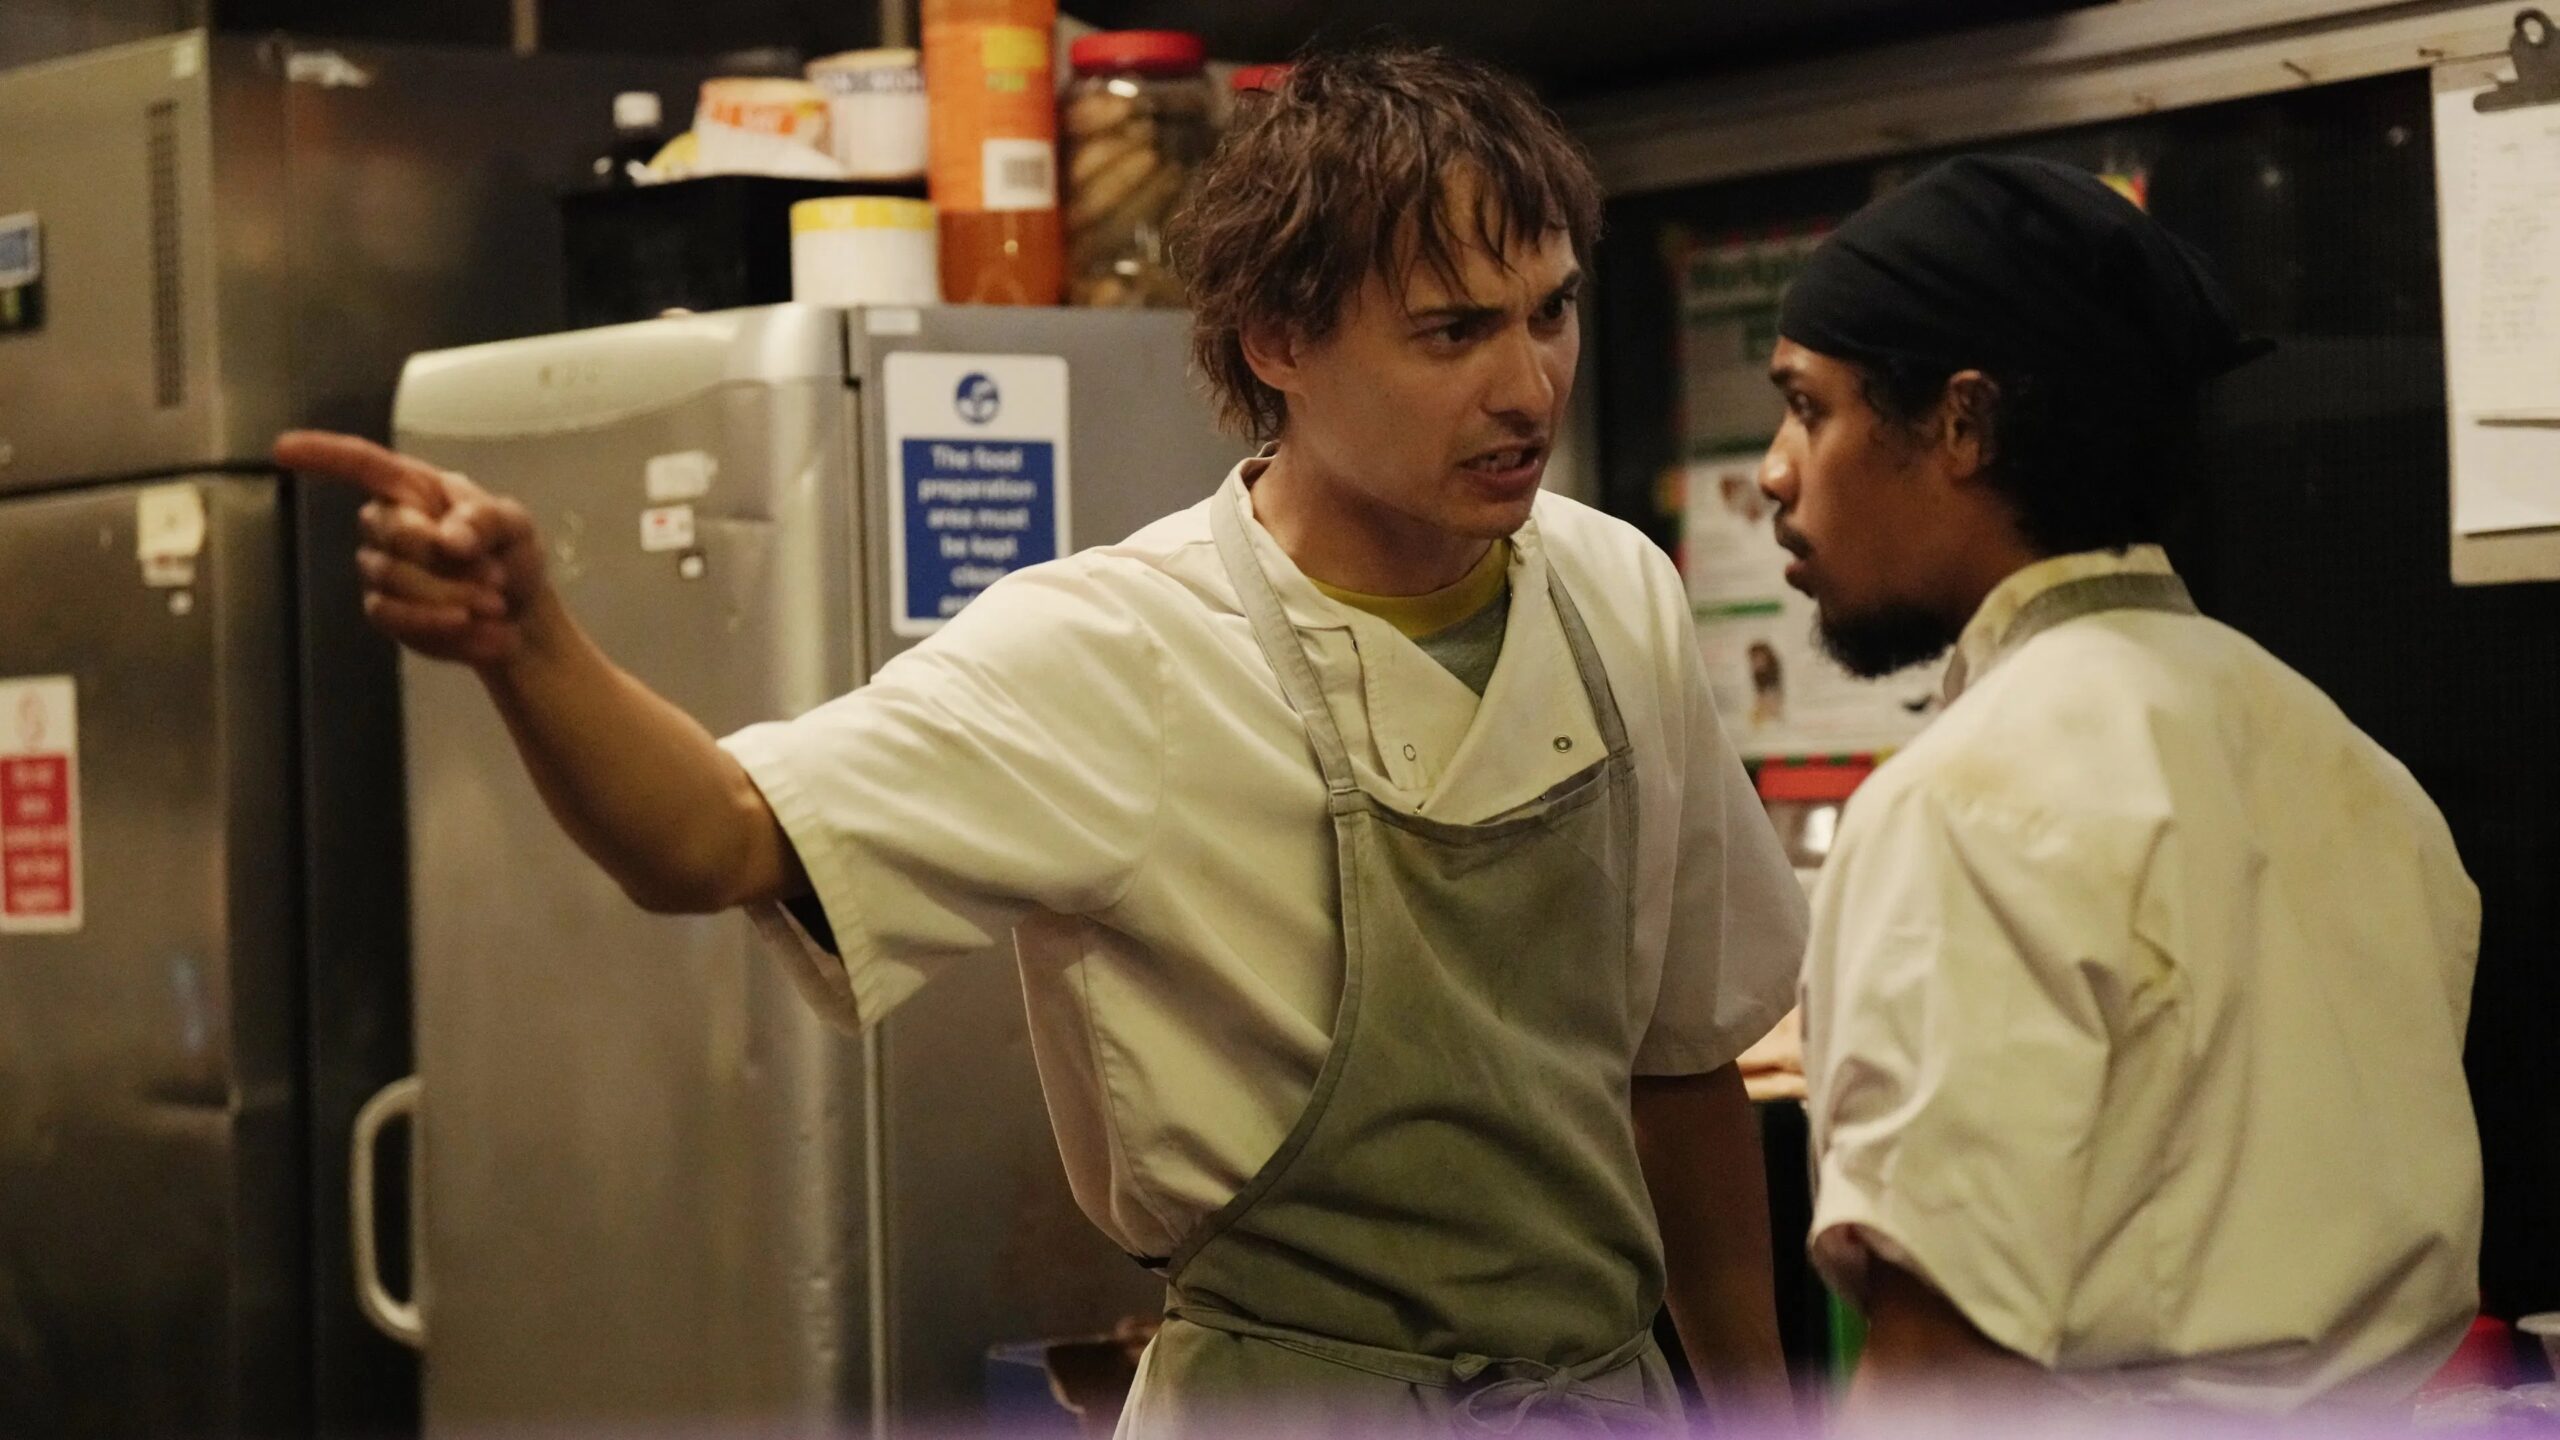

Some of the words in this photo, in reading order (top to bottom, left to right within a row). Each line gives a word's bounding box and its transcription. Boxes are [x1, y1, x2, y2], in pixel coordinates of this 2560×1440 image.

[933, 445, 969, 470] The
[974, 447, 1021, 471] food
[918, 479, 1036, 503] preparation
[927, 508, 973, 528] area
[976, 508, 1029, 529] must
[940, 535, 966, 557] be
[971, 535, 1017, 561] kept
